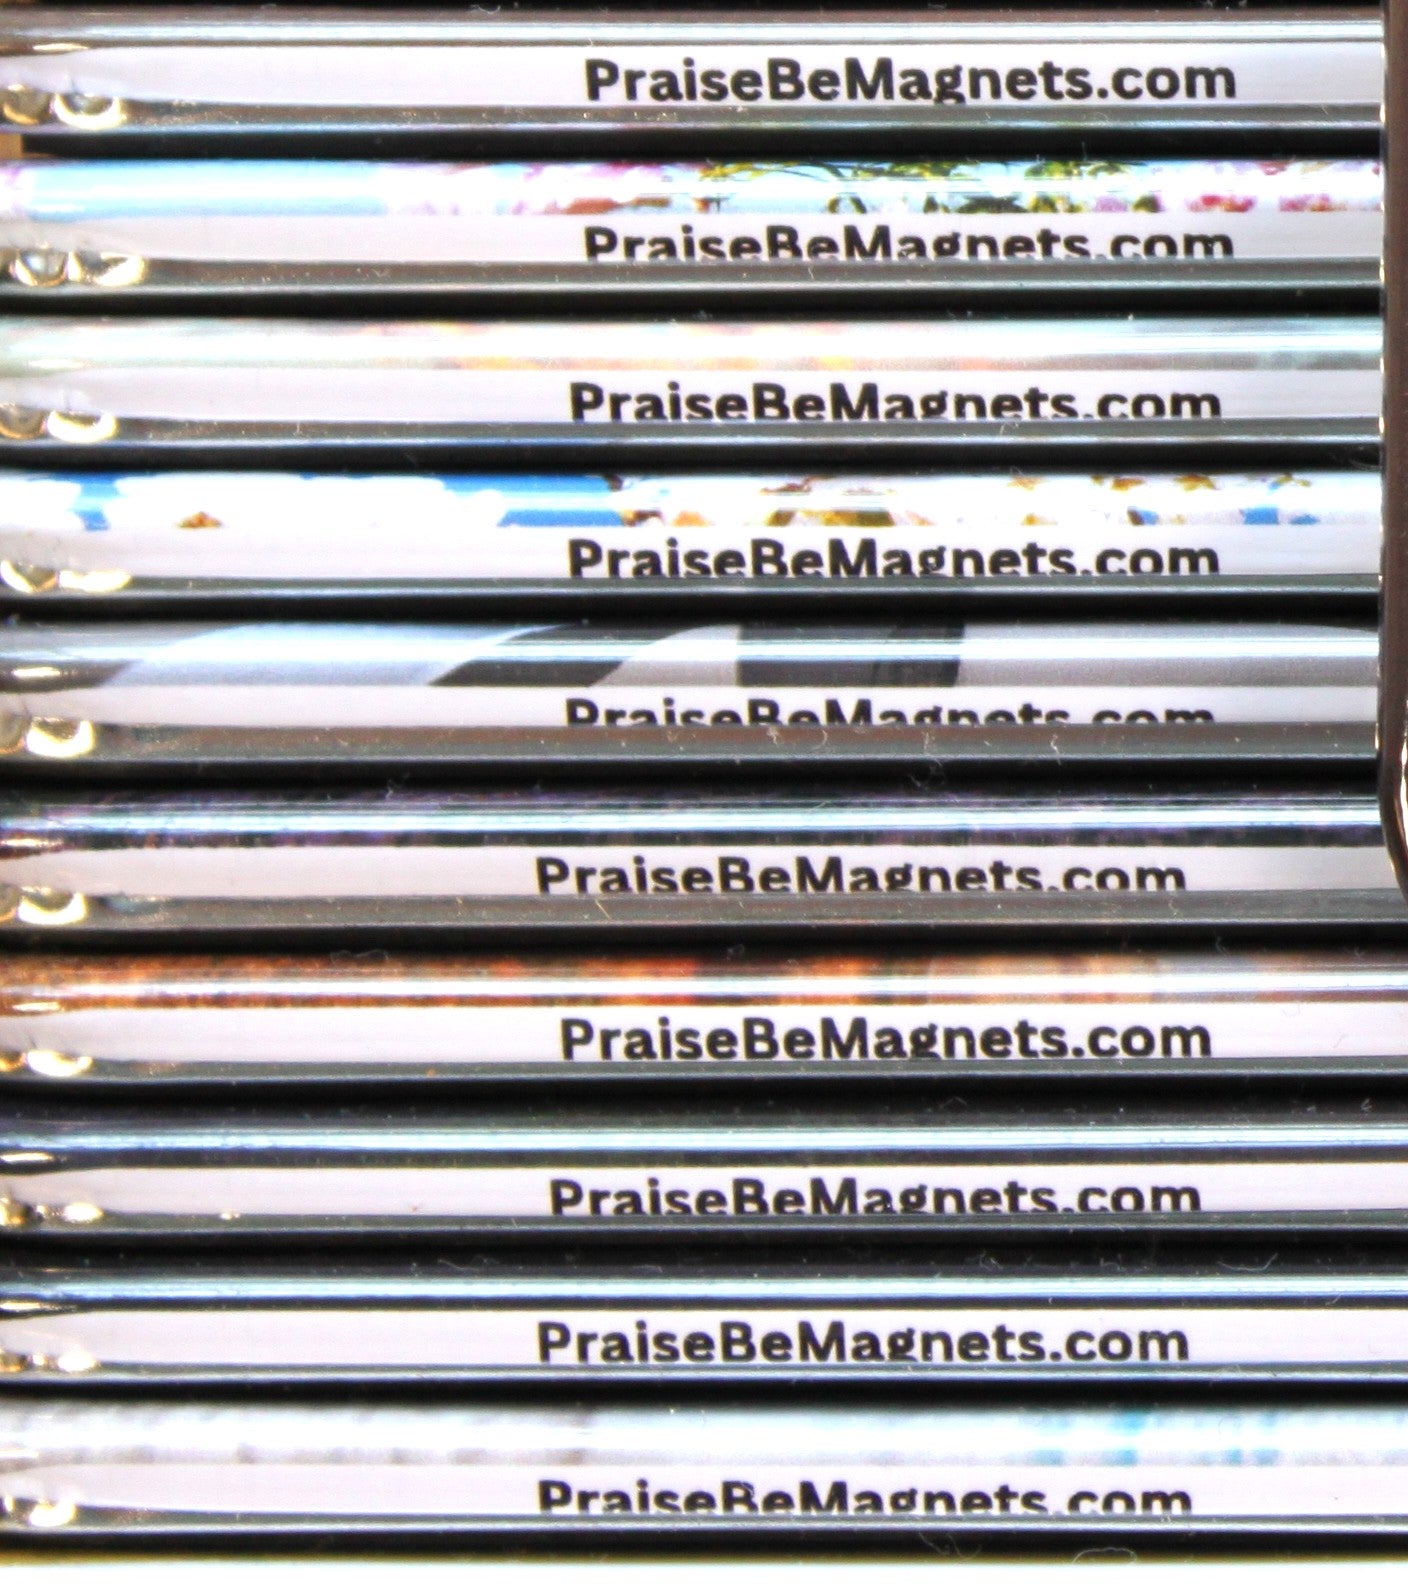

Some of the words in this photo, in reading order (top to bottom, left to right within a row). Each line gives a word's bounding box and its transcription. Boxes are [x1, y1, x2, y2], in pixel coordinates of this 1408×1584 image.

[585, 57, 1237, 104] PraiseBeMagnets.com
[584, 225, 1233, 259] PraiseBeMagnetscom
[570, 382, 1221, 422] PraiseBeMagnets.com
[569, 538, 1219, 577] PraiseBeMagnets.com
[561, 1017, 1212, 1061] PraiseBeMagnets.com
[550, 1178, 1201, 1216] PraiseBeMagnets.com
[537, 1320, 1189, 1362] PraiseBeMagnets.com
[538, 1480, 1192, 1514] PraiseBeMagnetscom
